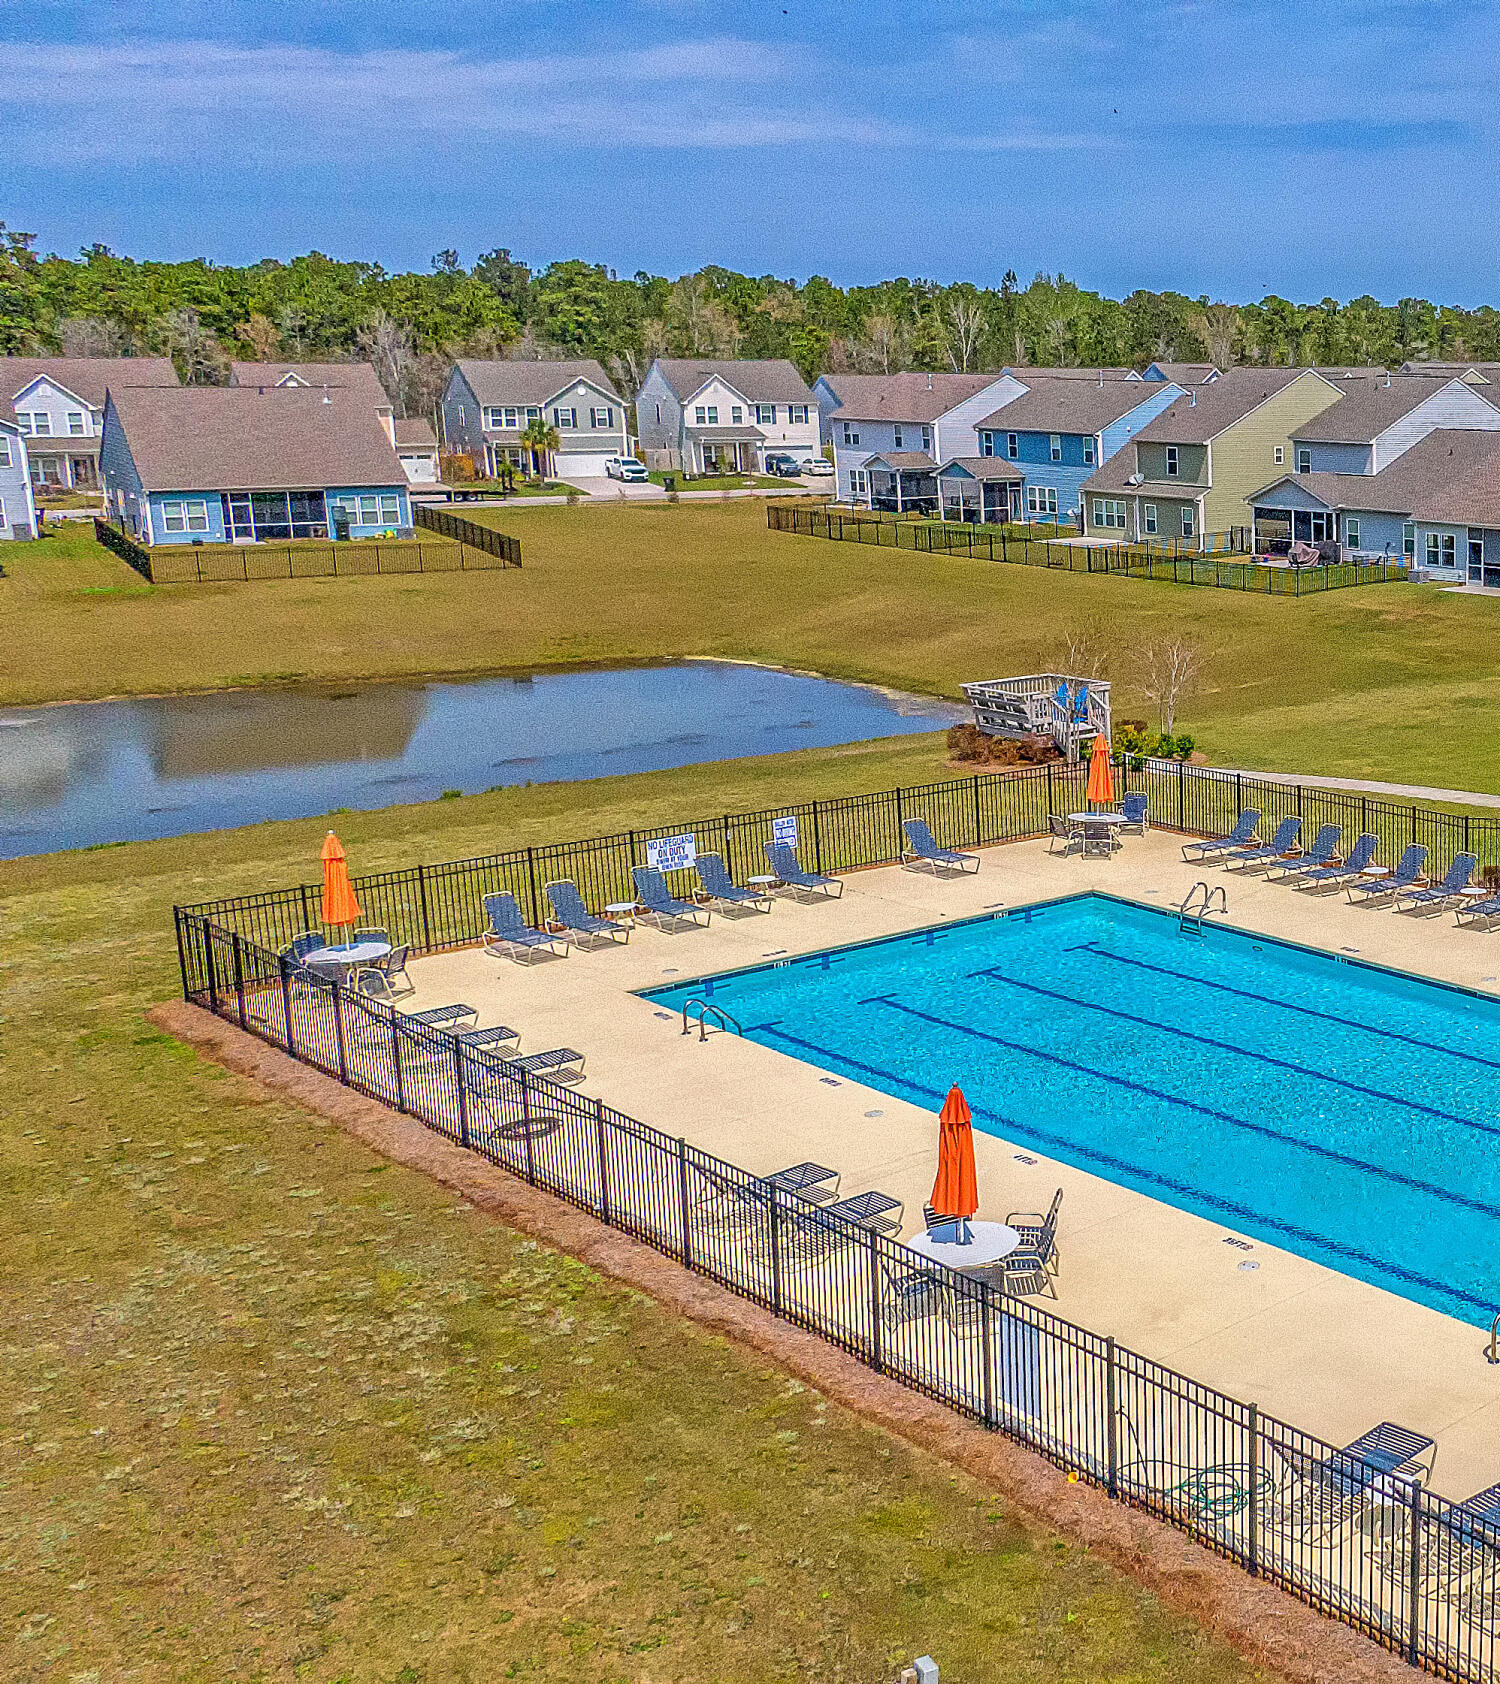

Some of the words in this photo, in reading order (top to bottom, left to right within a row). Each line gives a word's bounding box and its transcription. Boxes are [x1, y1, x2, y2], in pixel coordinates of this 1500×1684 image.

[648, 841, 658, 850] NO
[659, 835, 694, 848] LIFEGUARD
[658, 849, 668, 858] ON
[669, 845, 686, 856] DUTY
